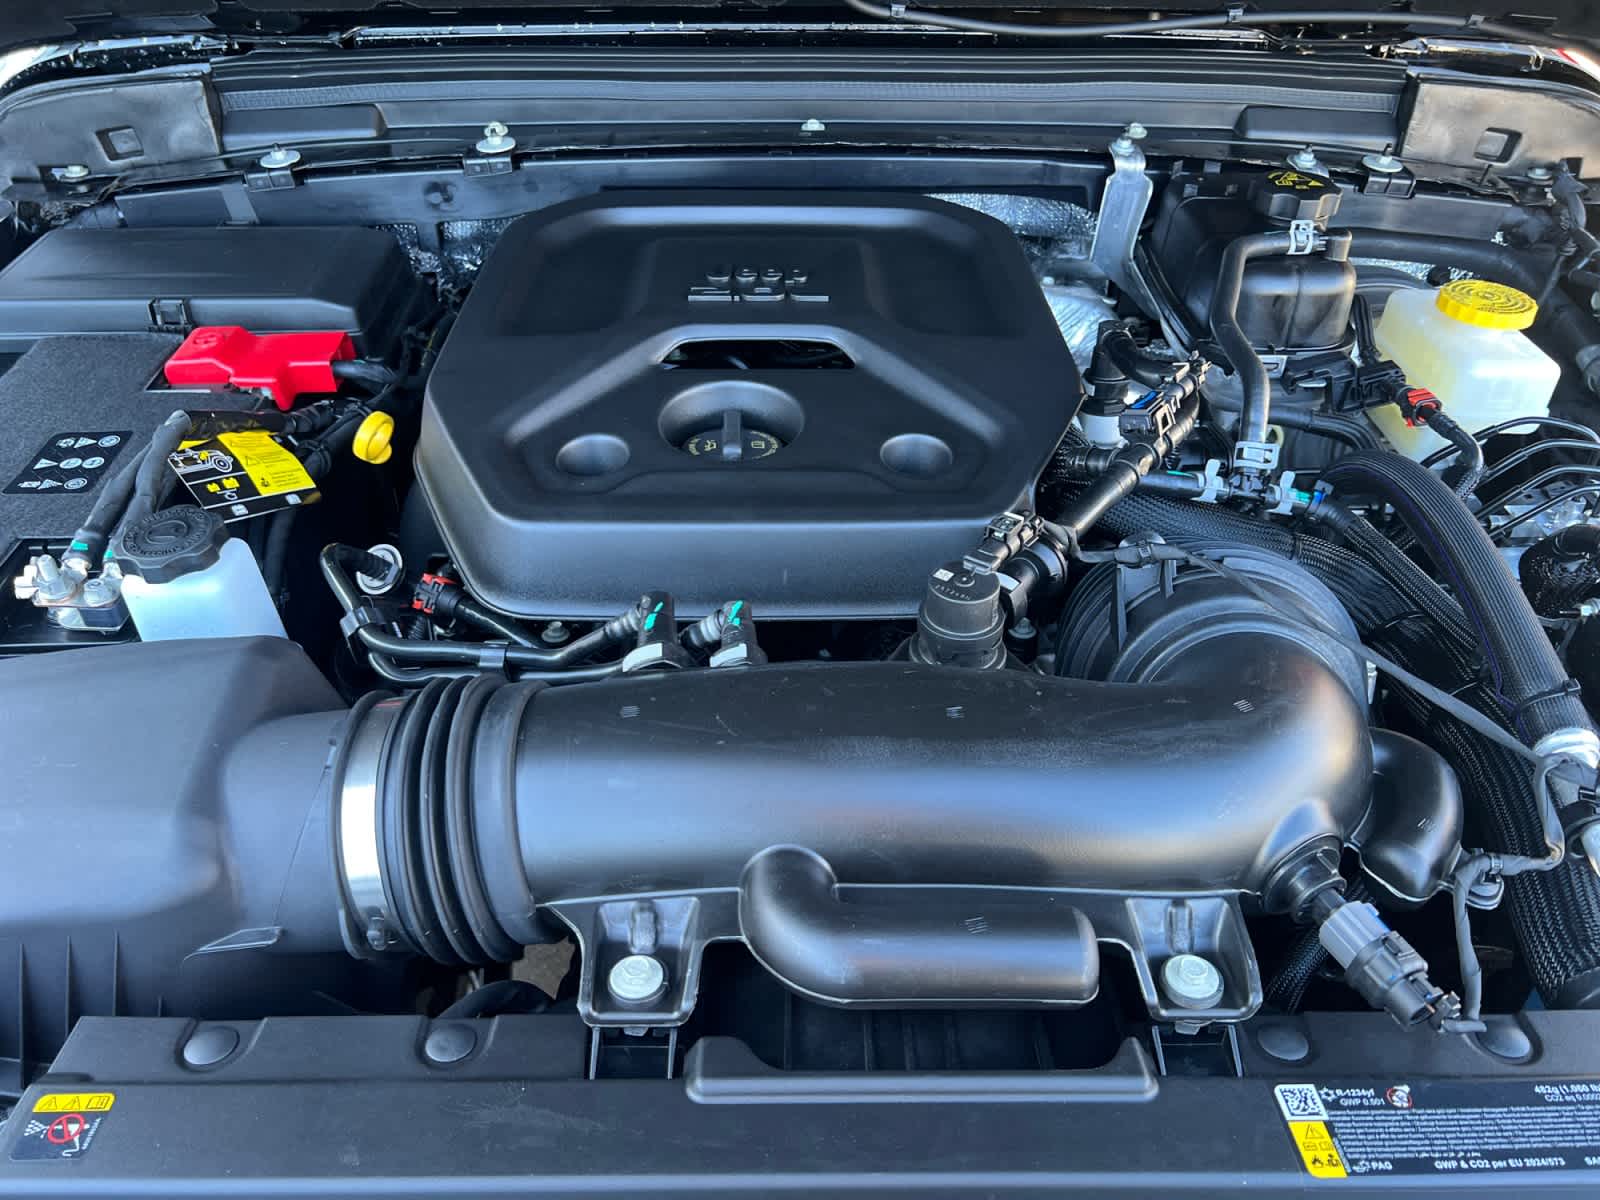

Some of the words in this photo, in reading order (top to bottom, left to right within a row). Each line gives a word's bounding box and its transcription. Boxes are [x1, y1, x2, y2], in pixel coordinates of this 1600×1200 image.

[1340, 1098, 1361, 1106] GWP
[1371, 1161, 1393, 1171] PAG
[1434, 1160, 1458, 1170] GWP
[1469, 1159, 1491, 1169] CO2
[1508, 1158, 1523, 1168] EU
